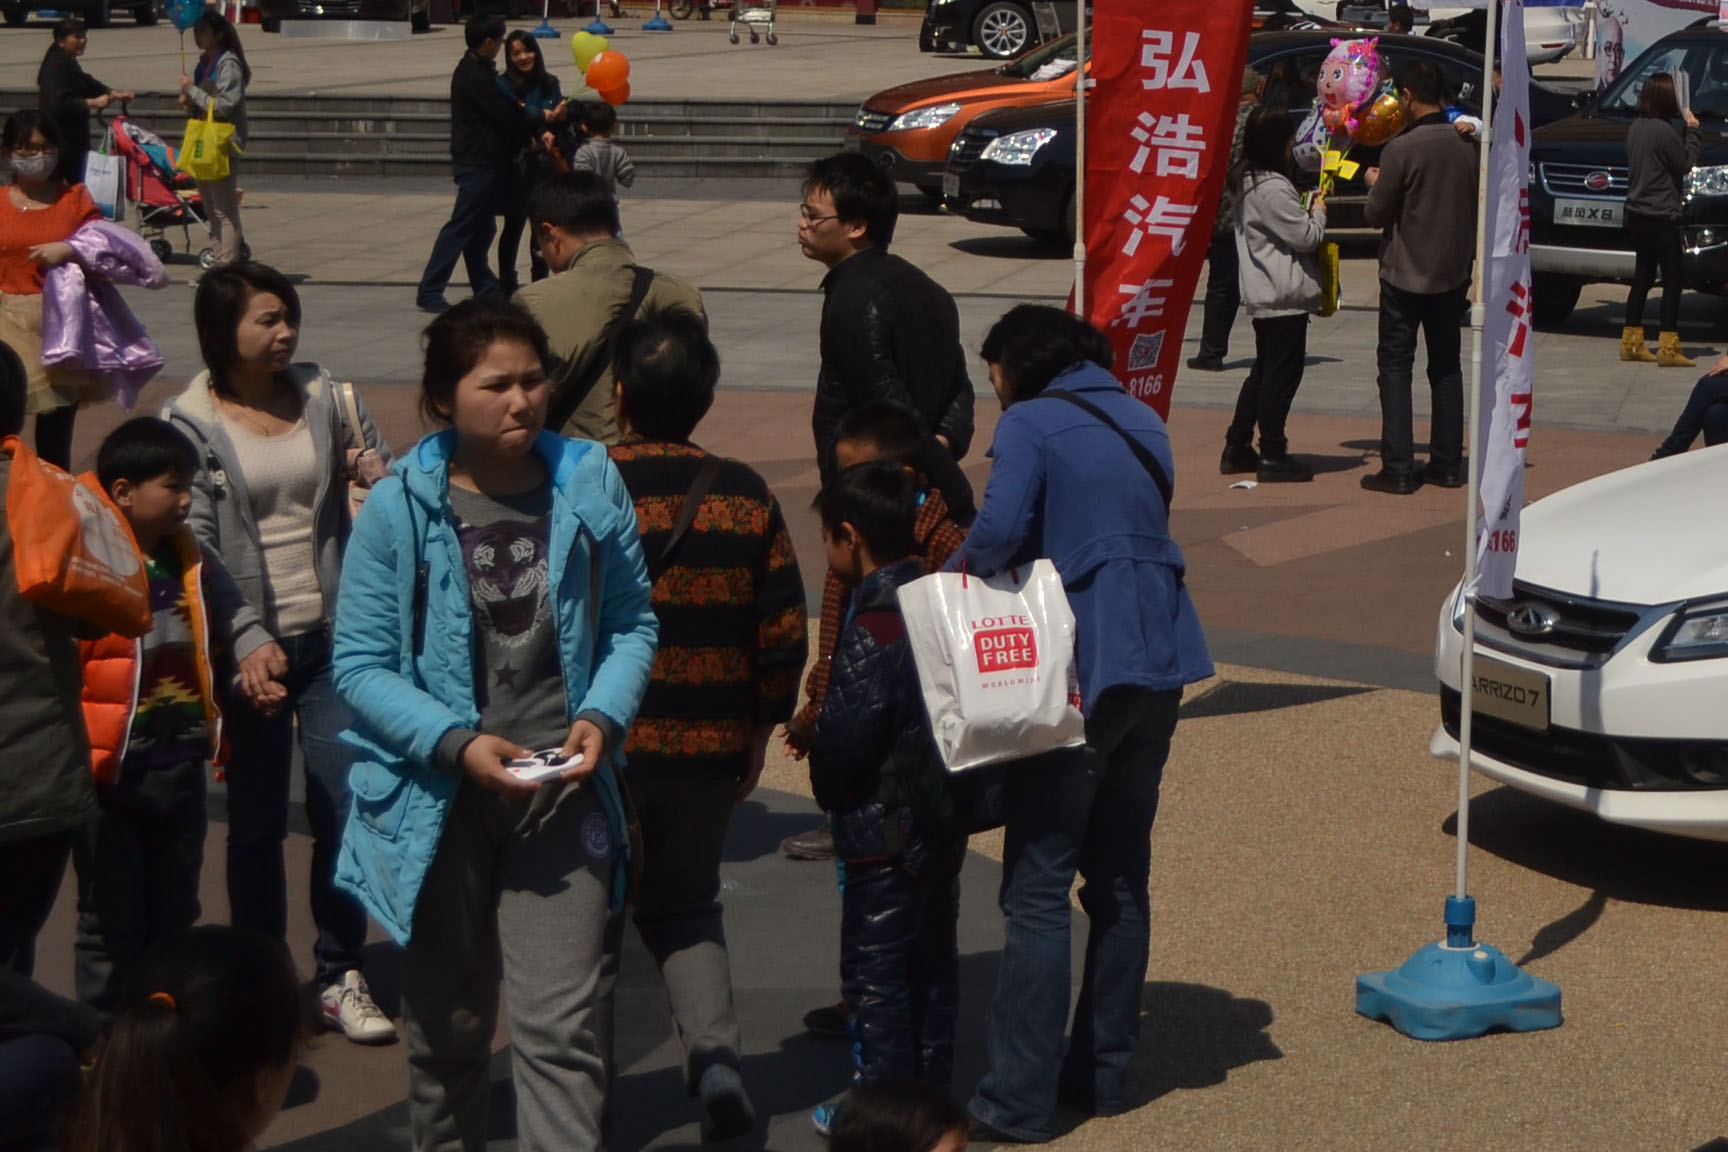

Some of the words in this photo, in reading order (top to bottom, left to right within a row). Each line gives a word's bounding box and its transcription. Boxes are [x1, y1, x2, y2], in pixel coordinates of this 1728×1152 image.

[1111, 29, 1210, 328] 弘浩汽车
[1562, 206, 1613, 220] 陆风X8
[971, 615, 1032, 630] LOTTE
[980, 632, 1030, 651] DUTY
[983, 647, 1032, 666] FREE
[1528, 688, 1539, 707] 7
